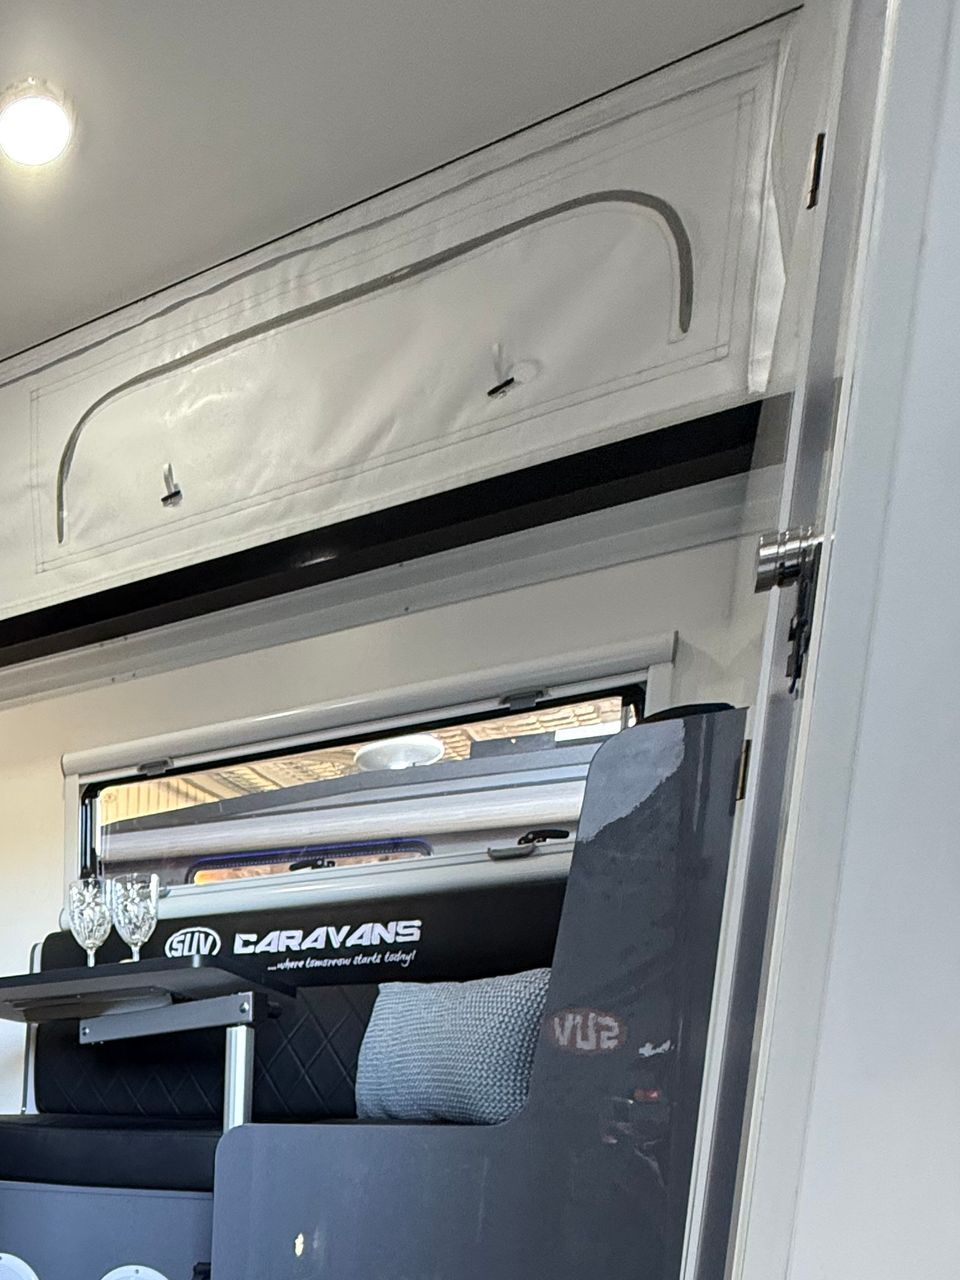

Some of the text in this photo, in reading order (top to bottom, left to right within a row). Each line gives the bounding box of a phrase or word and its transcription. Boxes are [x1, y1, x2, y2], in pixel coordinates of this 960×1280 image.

[169, 919, 422, 957] SUV CARAVANS
[305, 956, 351, 969] tomorrow
[352, 953, 382, 966] starts
[384, 949, 416, 968] today!
